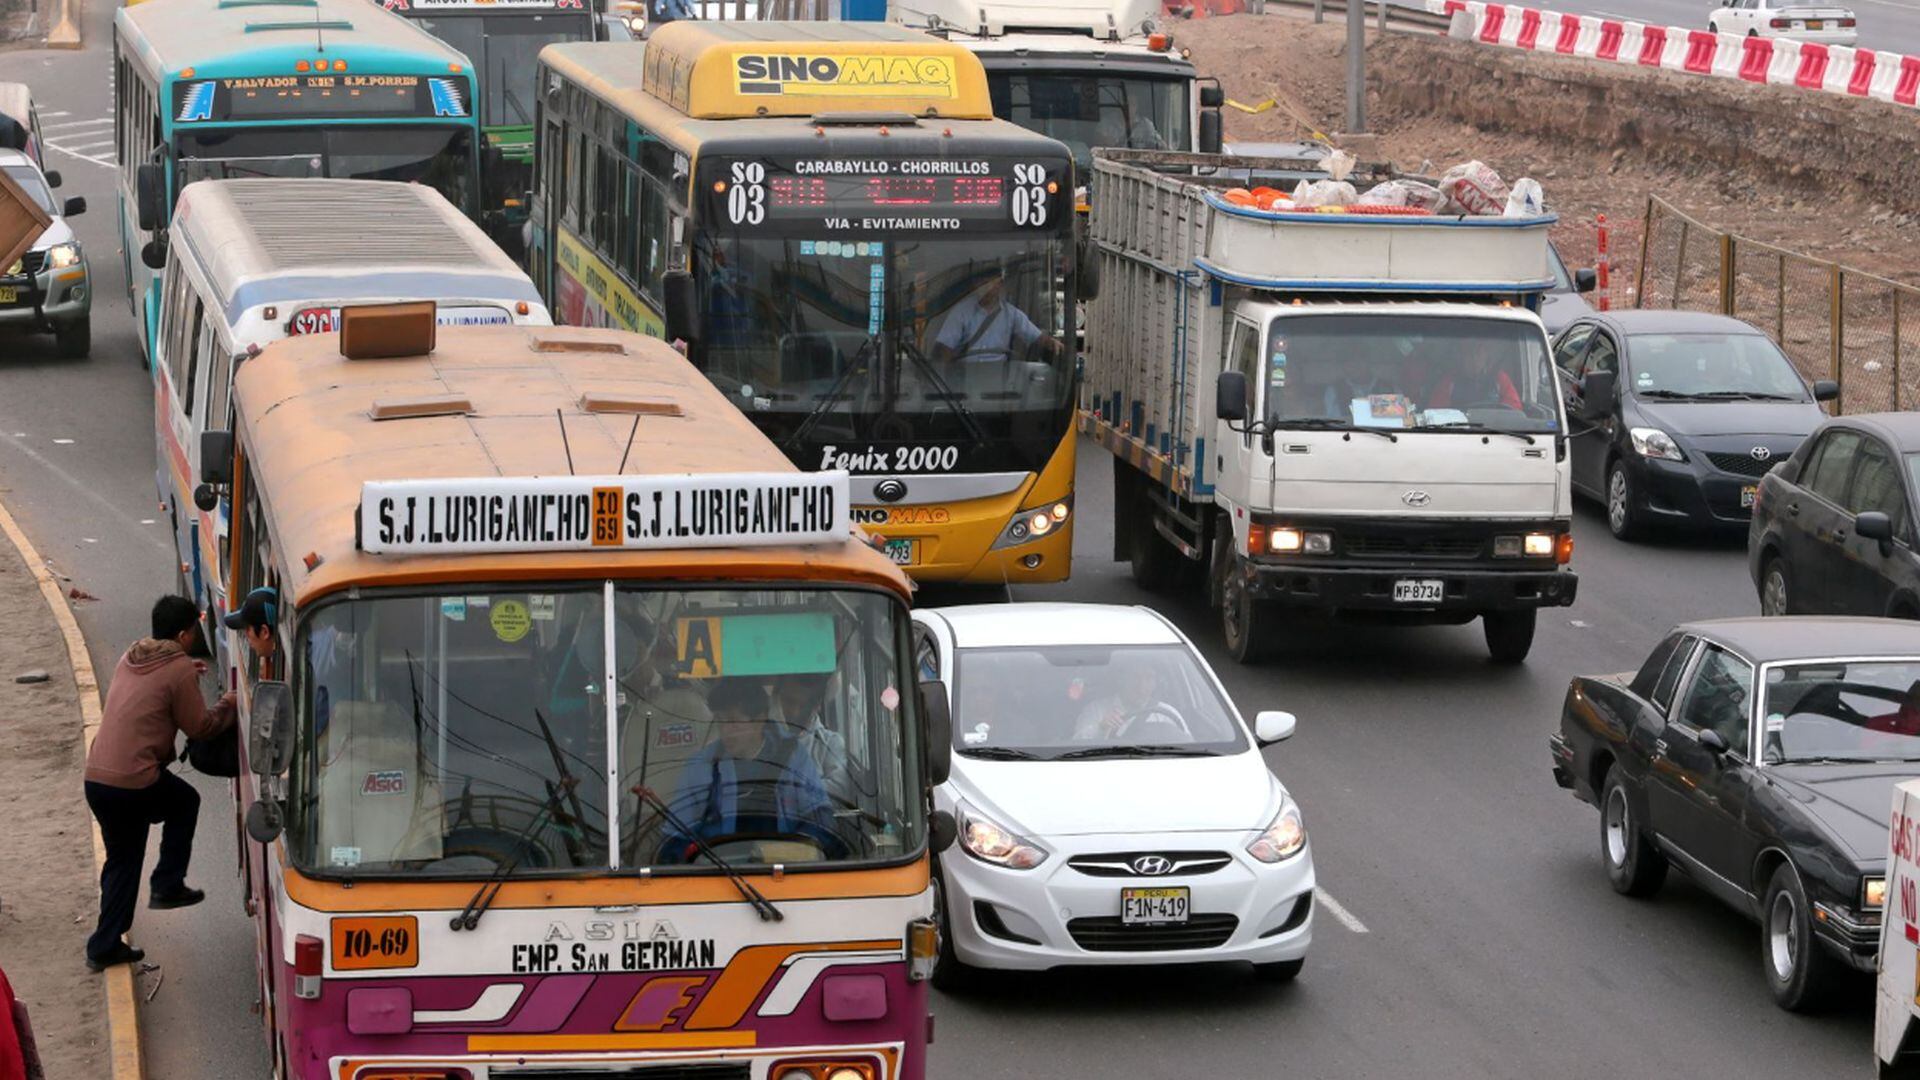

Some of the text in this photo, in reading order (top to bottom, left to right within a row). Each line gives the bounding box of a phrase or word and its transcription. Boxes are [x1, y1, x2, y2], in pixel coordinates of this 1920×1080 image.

[737, 55, 951, 84] SINOMAQ
[731, 162, 765, 184] SO
[795, 161, 889, 174] CARABAYLLO
[901, 161, 990, 175] CHORRILLOS
[1013, 163, 1046, 185] SO
[728, 184, 765, 225] 03
[1012, 186, 1047, 226] 03
[825, 218, 850, 229] VIA
[862, 218, 960, 229] EVITAMIENTO
[820, 446, 958, 471] Fenix 2000
[379, 494, 590, 544] S.J.LURIGANCHO
[626, 485, 834, 539] S.J.LURIGANCHO
[596, 518, 617, 541] 69
[1891, 811, 1913, 862] GAS
[1124, 897, 1186, 918] F1N-419
[1901, 875, 1917, 924] NO
[545, 919, 679, 941] ASIA
[512, 944, 561, 972] EMP.
[621, 939, 715, 970] GERMAN
